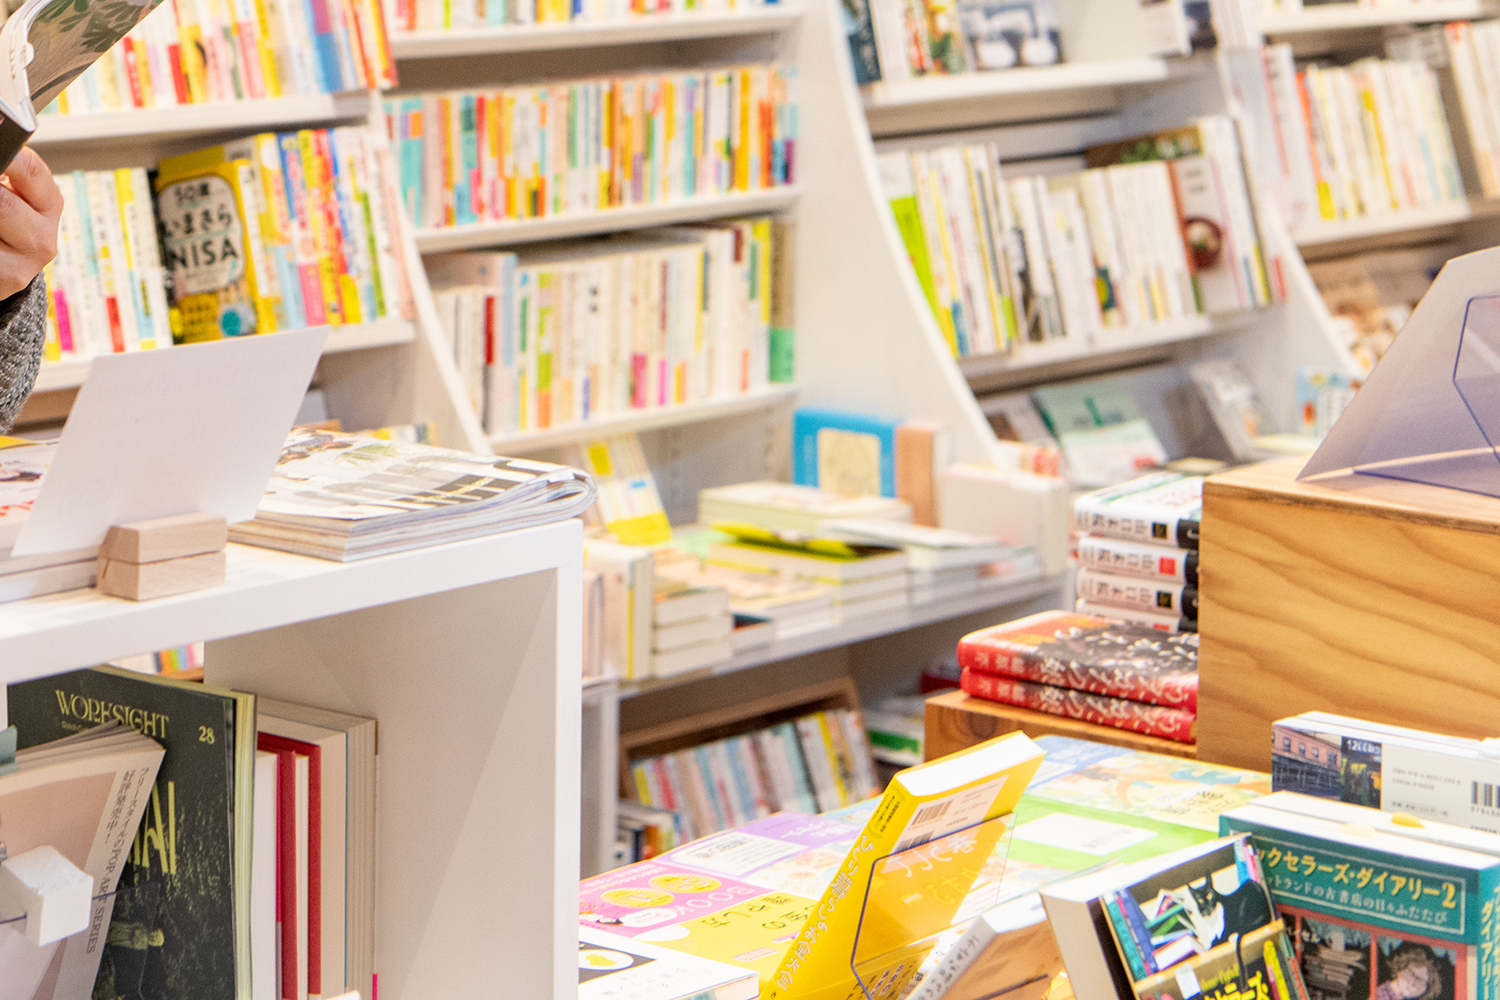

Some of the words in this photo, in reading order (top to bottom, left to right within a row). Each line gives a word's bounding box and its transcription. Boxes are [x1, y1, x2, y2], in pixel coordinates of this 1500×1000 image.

[55, 689, 170, 739] WORKSIGHT
[198, 725, 215, 745] 28
[86, 907, 106, 955] SERIES
